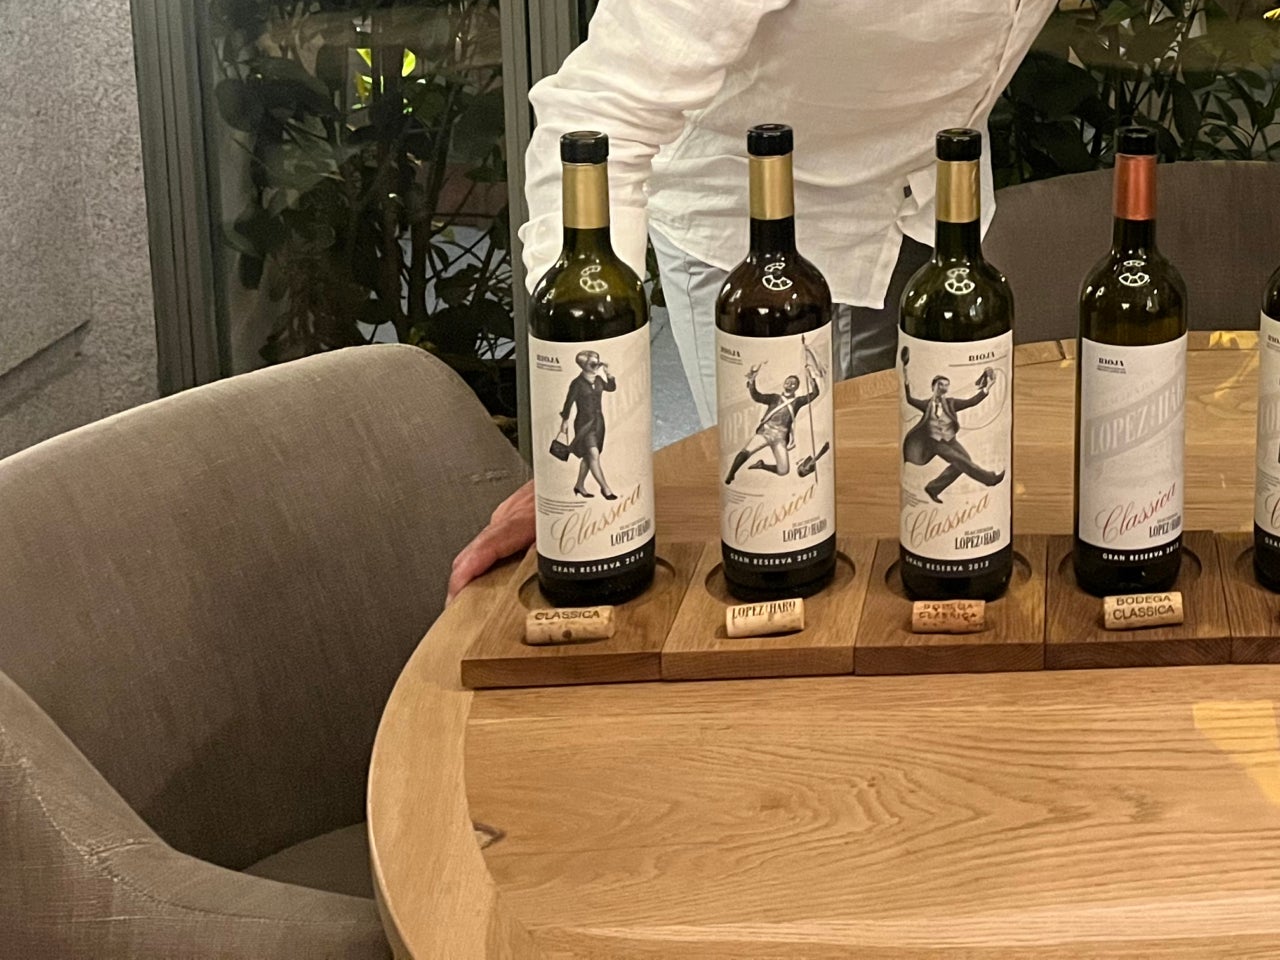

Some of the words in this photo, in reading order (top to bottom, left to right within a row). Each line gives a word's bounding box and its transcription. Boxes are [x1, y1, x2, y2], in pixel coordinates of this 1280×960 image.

[968, 351, 995, 362] RIOJA
[1098, 357, 1124, 367] RIOJA
[551, 483, 641, 555] Classica
[728, 483, 816, 546] Classica
[1095, 482, 1176, 544] Classica
[905, 493, 990, 550] Classica
[783, 525, 808, 543] LOPEZ
[954, 535, 980, 550] LOPEZ
[730, 552, 750, 565] GRAN
[753, 556, 793, 566] RESERVA
[1102, 552, 1126, 561] GRAN
[1129, 550, 1163, 562] RESERVA
[552, 565, 576, 574] GRAN
[580, 560, 621, 574] RESERVA
[1115, 595, 1171, 606] BODEGA
[731, 605, 765, 620] LOPEZ
[768, 600, 796, 616] HARO
[1112, 604, 1175, 621] CLASSICA
